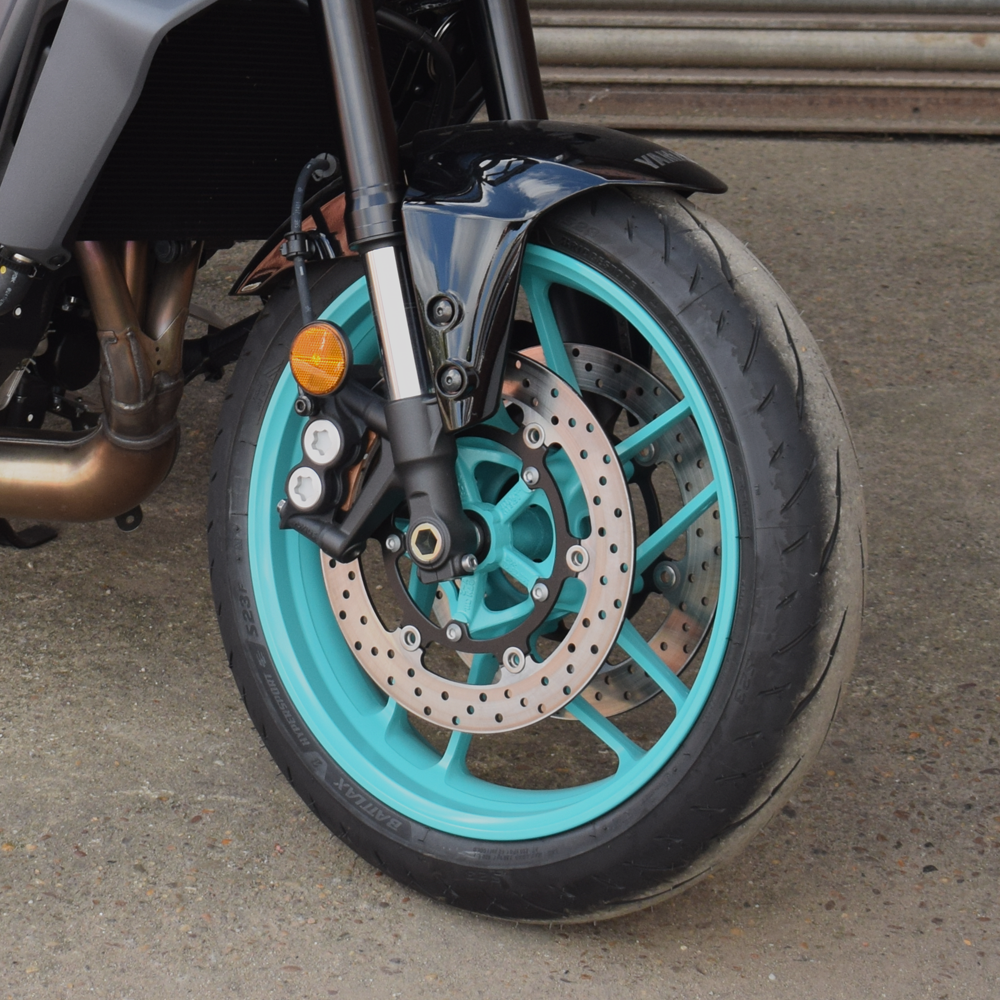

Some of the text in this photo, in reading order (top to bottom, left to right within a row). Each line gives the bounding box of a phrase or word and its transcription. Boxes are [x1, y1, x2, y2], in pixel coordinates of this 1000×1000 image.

[238, 582, 258, 637] S23F
[264, 673, 310, 746] HYPERSPORT
[333, 778, 402, 831] BATTLAX
